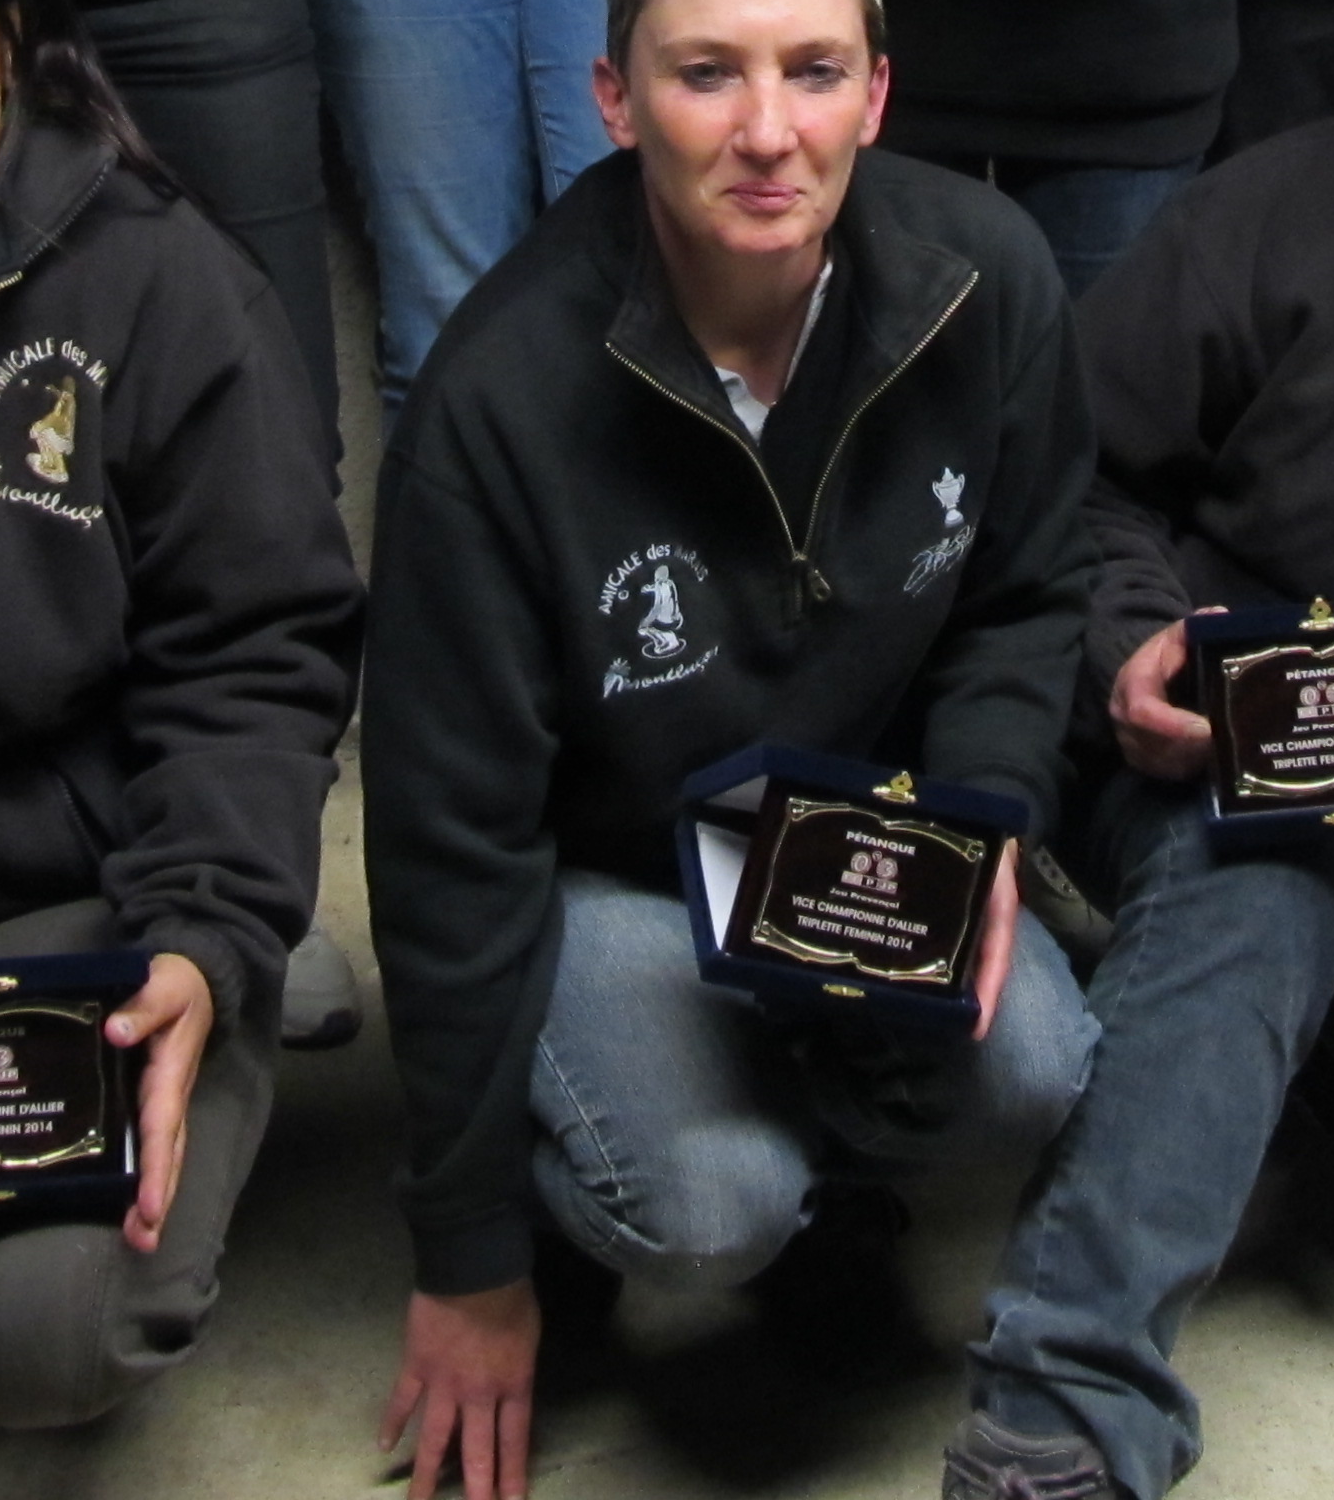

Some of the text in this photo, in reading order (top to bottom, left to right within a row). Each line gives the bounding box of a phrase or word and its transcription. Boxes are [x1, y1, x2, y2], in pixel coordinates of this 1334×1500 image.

[61, 339, 88, 367] des
[598, 551, 643, 615] AMICALE
[646, 543, 671, 560] des
[1260, 743, 1283, 754] VICE
[1273, 756, 1317, 769] TRIPLETTE
[846, 831, 916, 856] PÉTANQUE
[792, 895, 929, 936] VICE CHAMPIONNE D'ALLIER
[798, 915, 913, 950] TRIPLETTE FEMININ 2014
[19, 1101, 65, 1115] D'ALLIER
[24, 1121, 53, 1134] 2014
